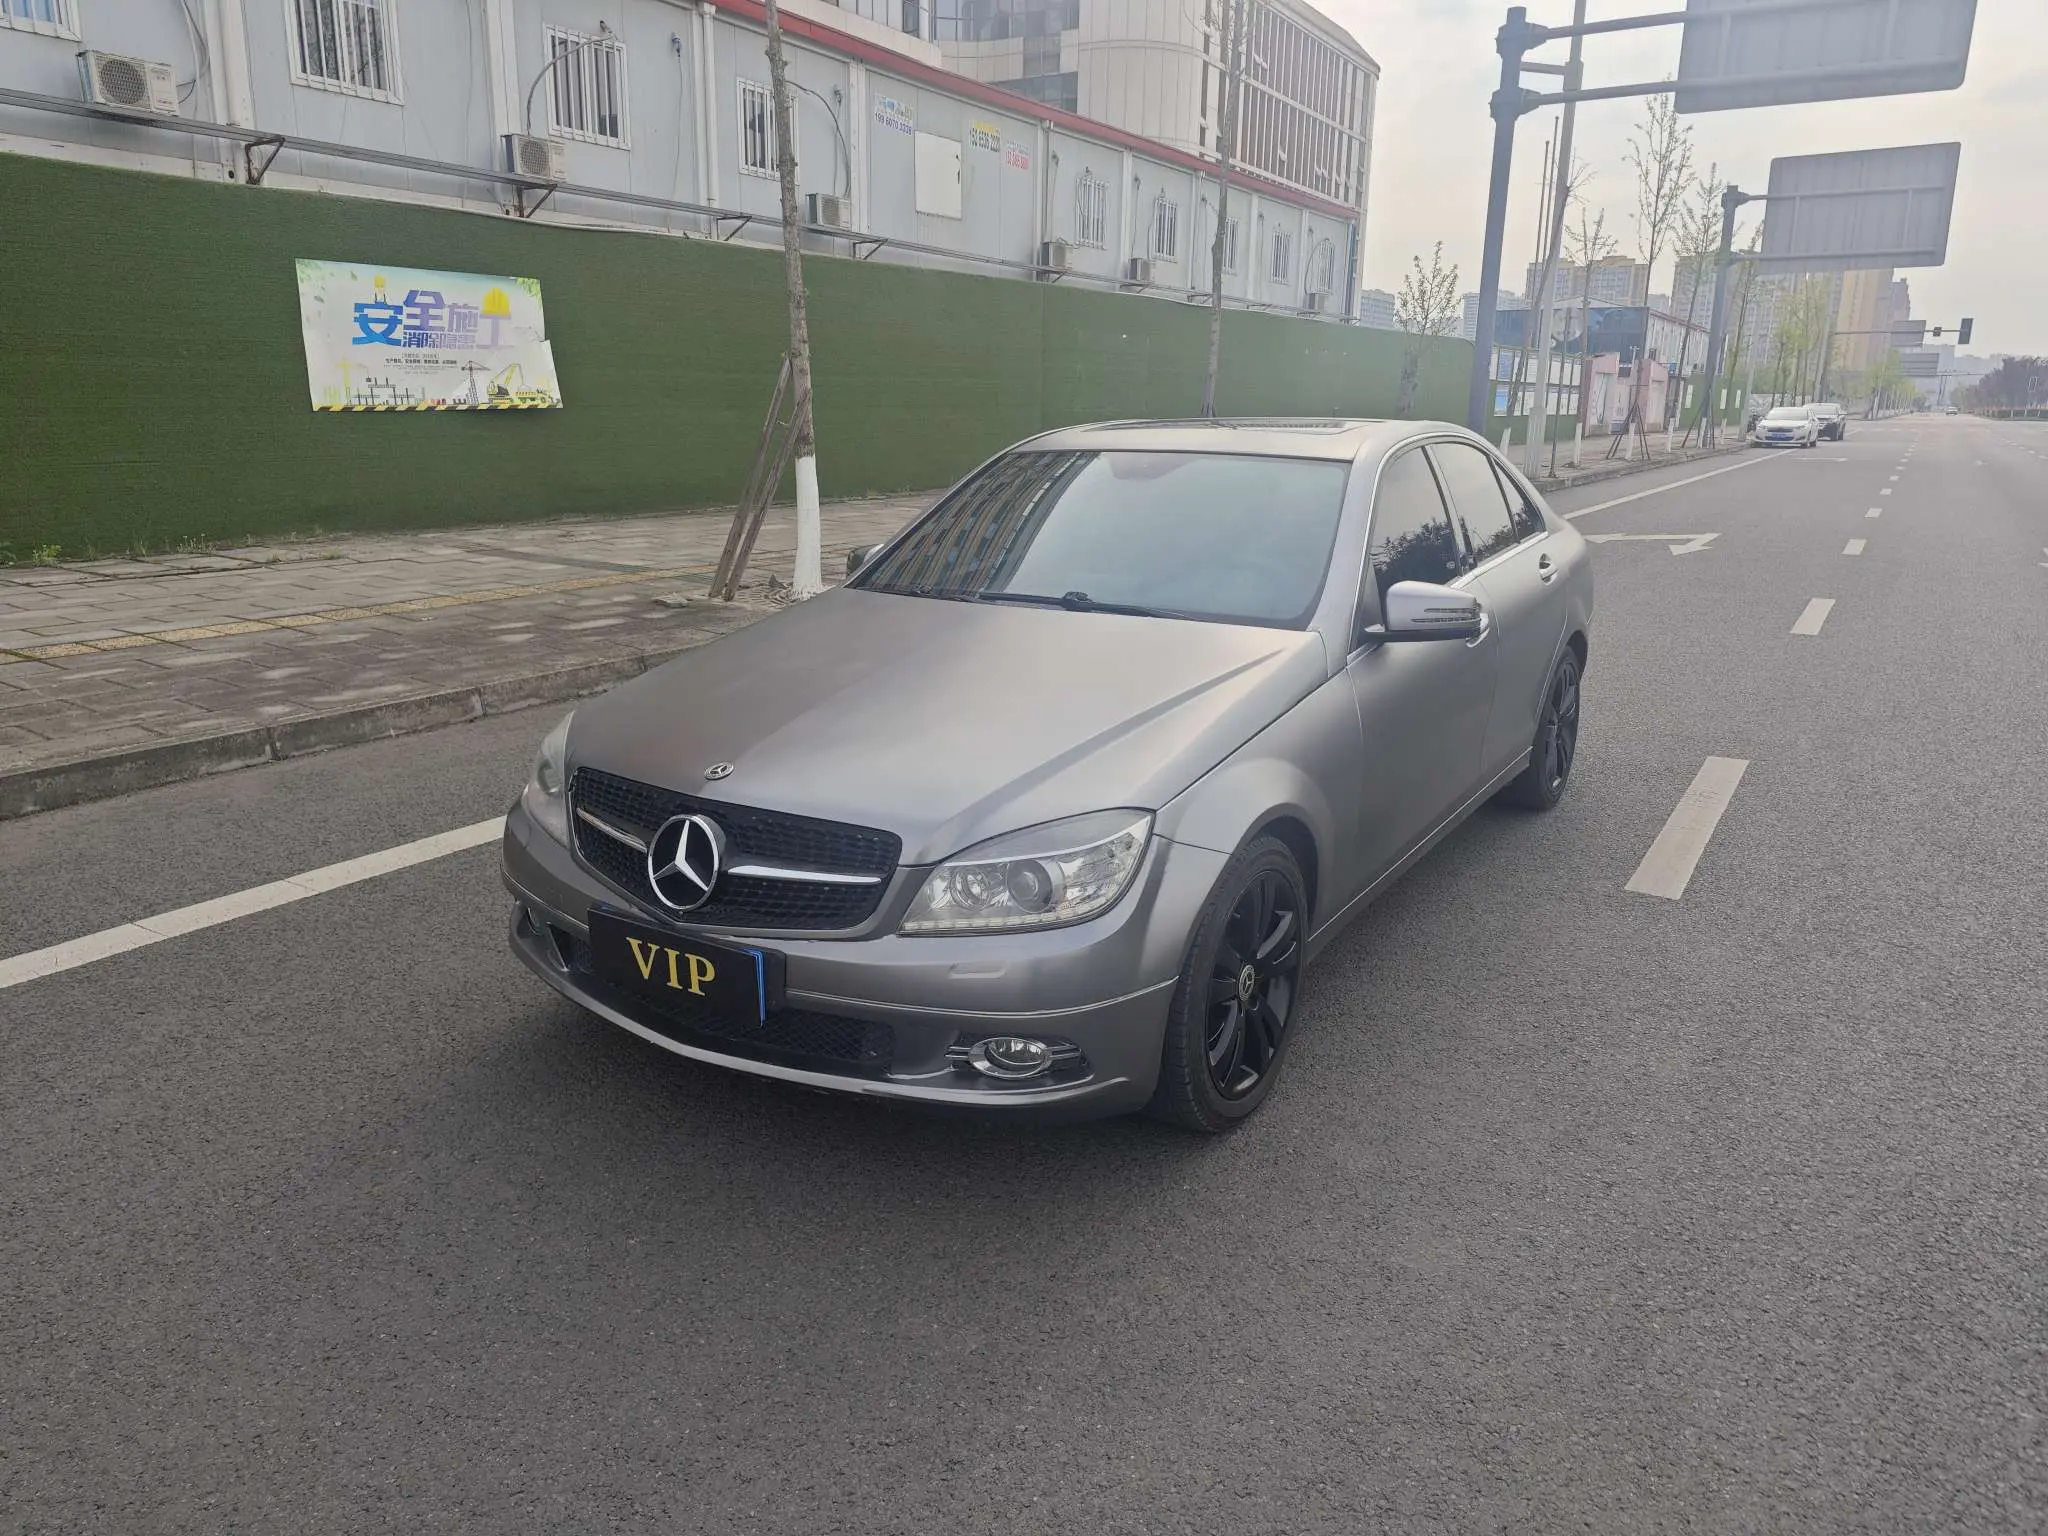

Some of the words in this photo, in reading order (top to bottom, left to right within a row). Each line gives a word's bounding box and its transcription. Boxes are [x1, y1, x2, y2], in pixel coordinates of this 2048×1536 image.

[352, 289, 514, 349] 安全施工
[626, 936, 716, 997] VIP
